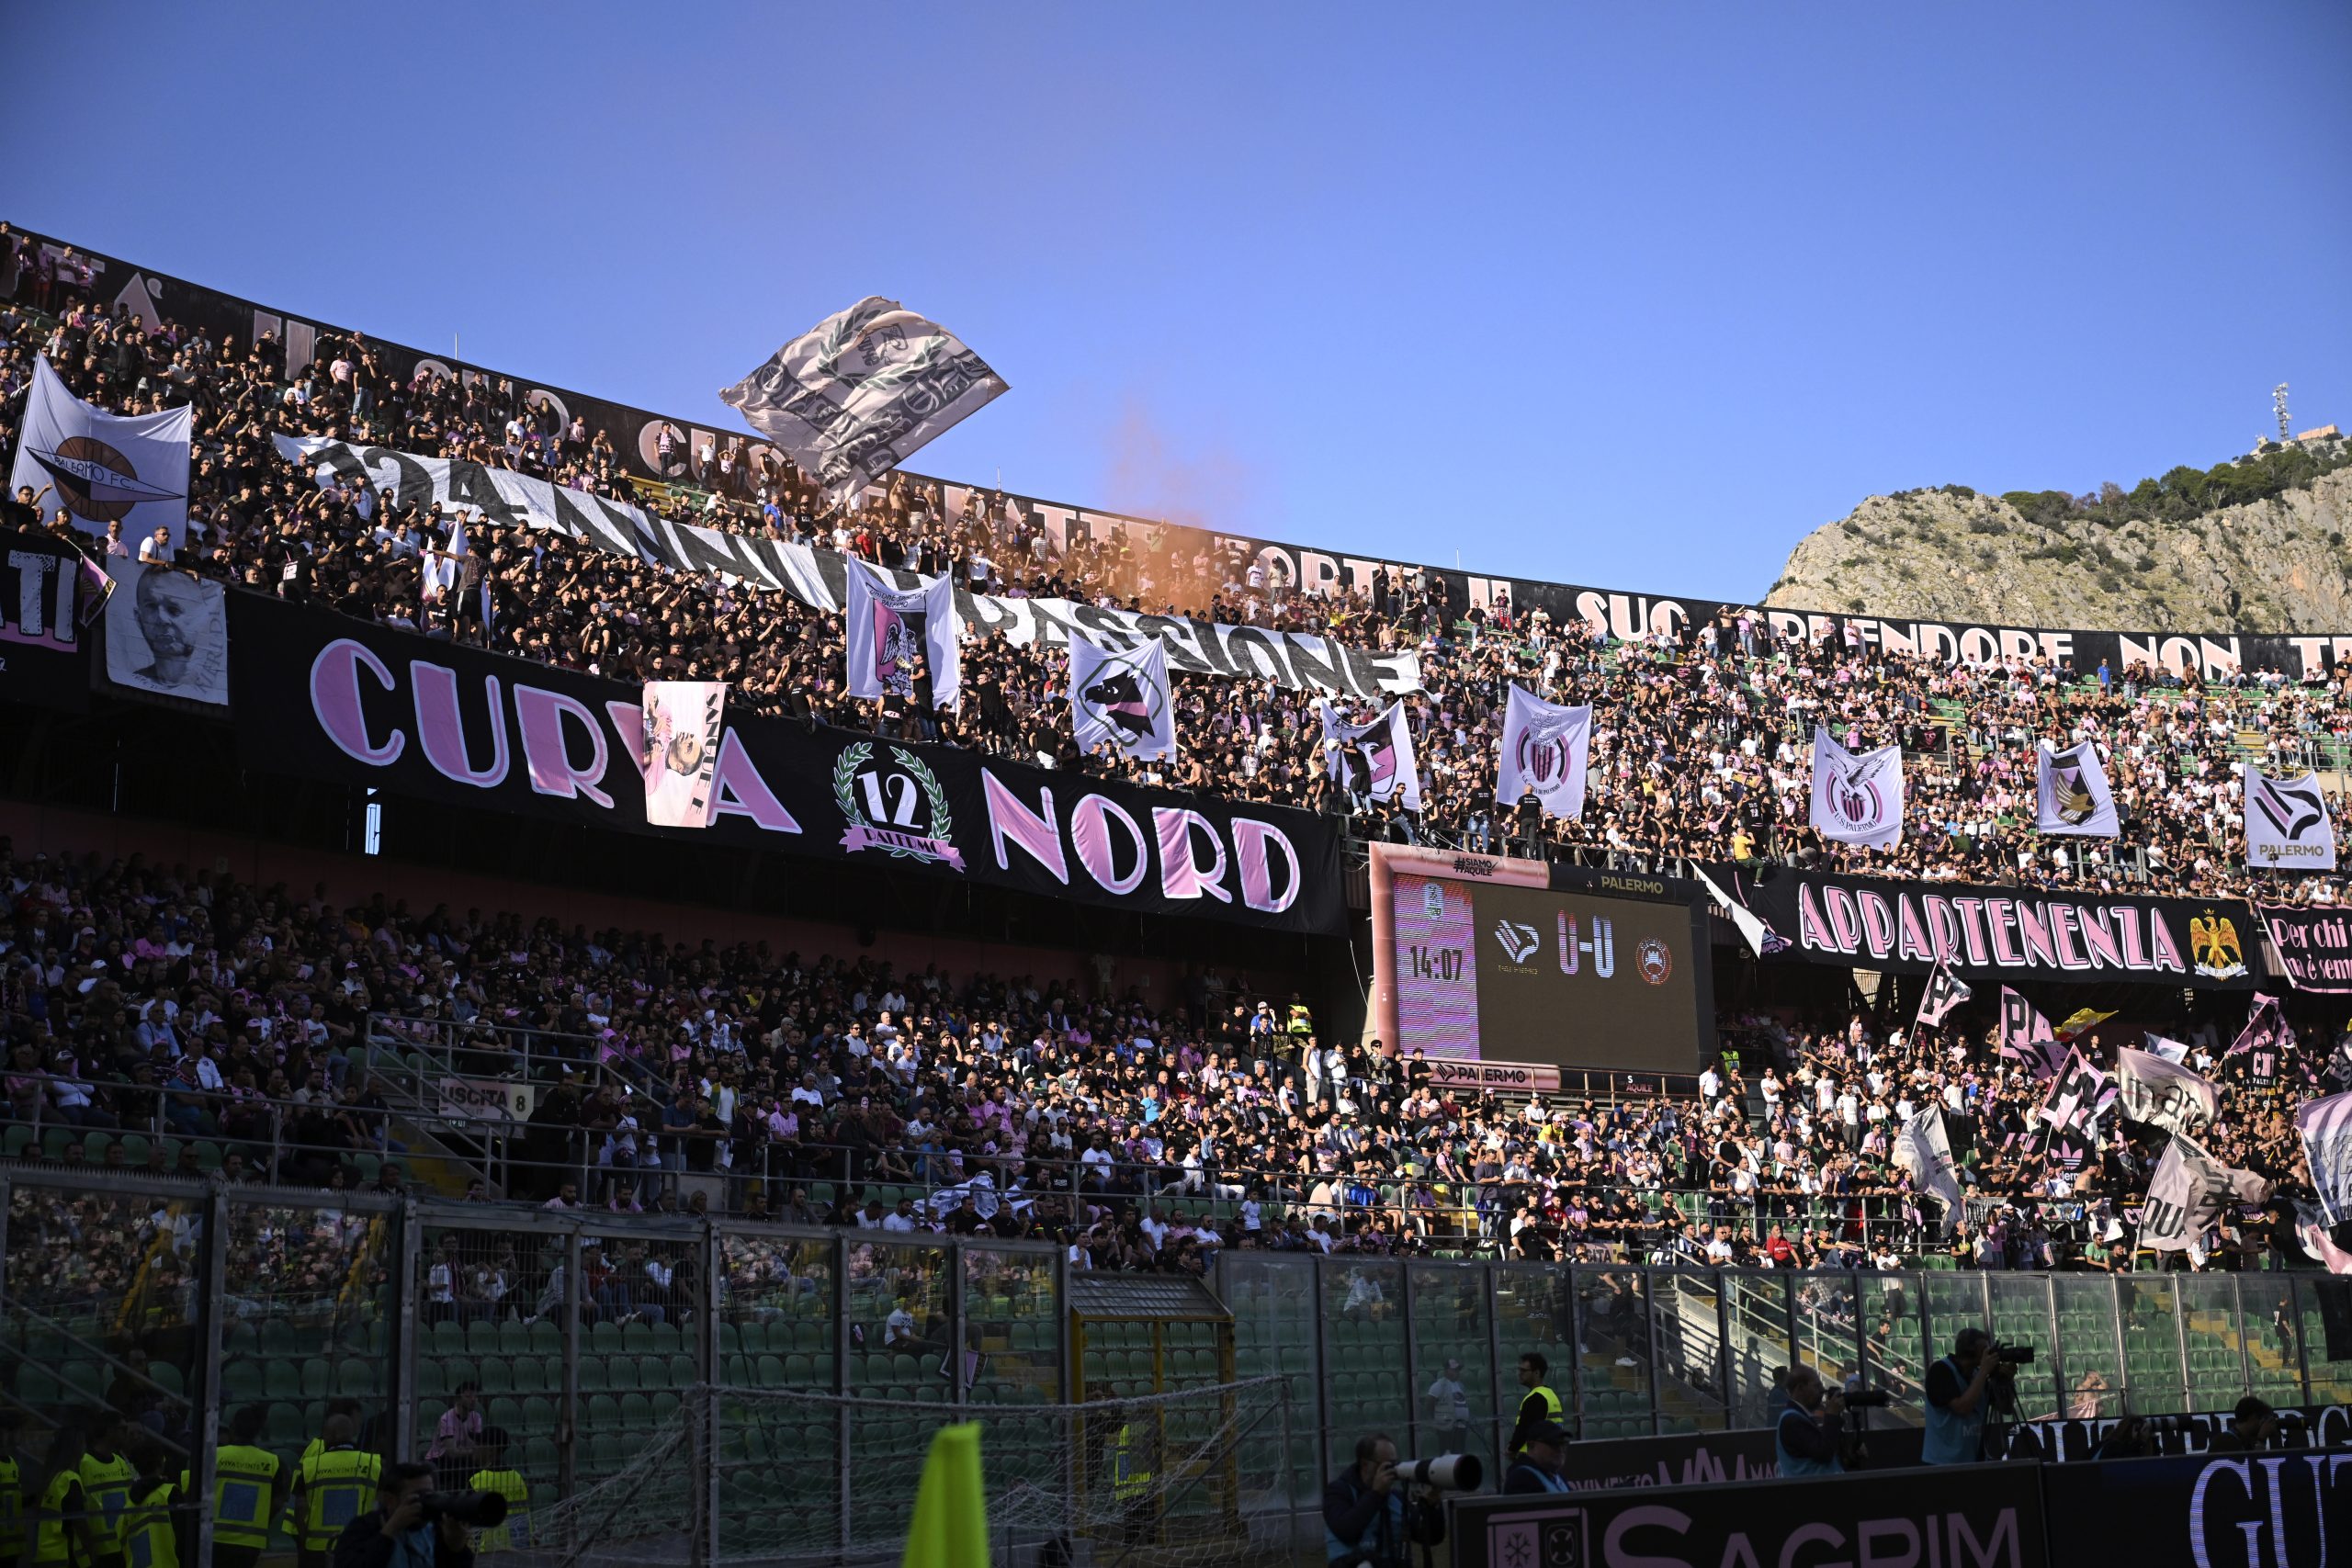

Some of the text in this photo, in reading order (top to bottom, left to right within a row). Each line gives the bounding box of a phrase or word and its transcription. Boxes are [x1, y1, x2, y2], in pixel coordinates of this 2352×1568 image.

[54, 457, 104, 480] PALERMO
[0, 549, 77, 643] TI
[2119, 634, 2243, 680] NON
[696, 693, 720, 788] SANGUE
[856, 771, 923, 829] 12
[863, 828, 943, 855] PALERMO
[981, 766, 1301, 913] NORD
[2259, 844, 2324, 857] PALERMO
[1464, 866, 1493, 876] AQUILE
[1601, 875, 1664, 895] PALERMO
[1798, 882, 2186, 974] APPARTENENZA
[2271, 919, 2309, 948] Per
[2313, 917, 2348, 948] chi
[1410, 945, 1464, 981] 14:07
[2319, 958, 2352, 980] sem
[1457, 1066, 1526, 1083] PAERMO
[515, 1095, 526, 1112] 8
[2189, 1452, 2352, 1568] GU
